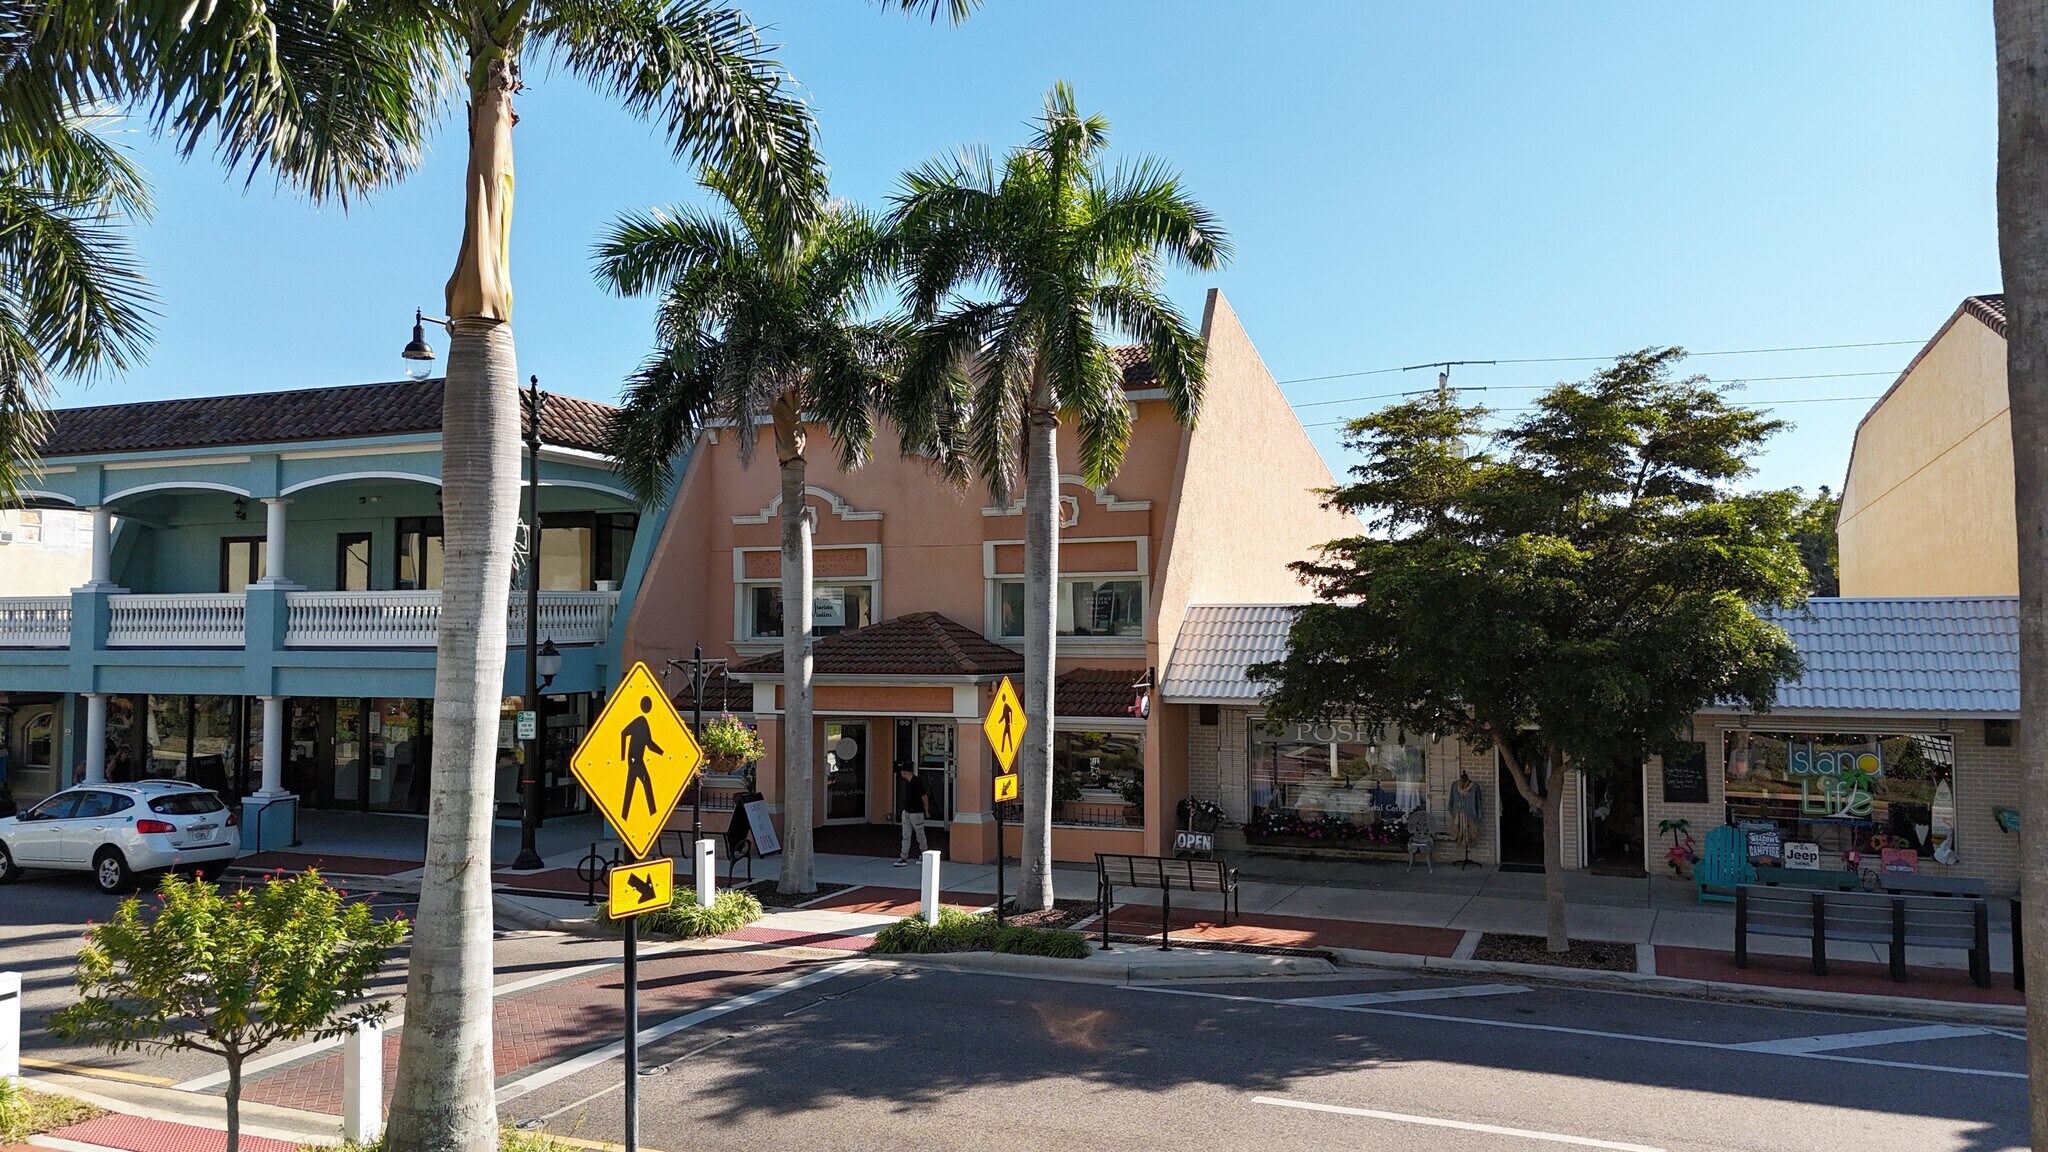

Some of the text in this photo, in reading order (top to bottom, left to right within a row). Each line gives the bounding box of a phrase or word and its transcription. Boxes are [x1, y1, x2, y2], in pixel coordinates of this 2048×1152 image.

[1787, 740, 1884, 777] Island
[1801, 777, 1874, 816] Life
[1178, 833, 1211, 850] OPEN
[1748, 832, 1780, 843] WELCOME
[1748, 845, 1780, 858] CAMPFIRE
[1786, 849, 1817, 863] Jeep
